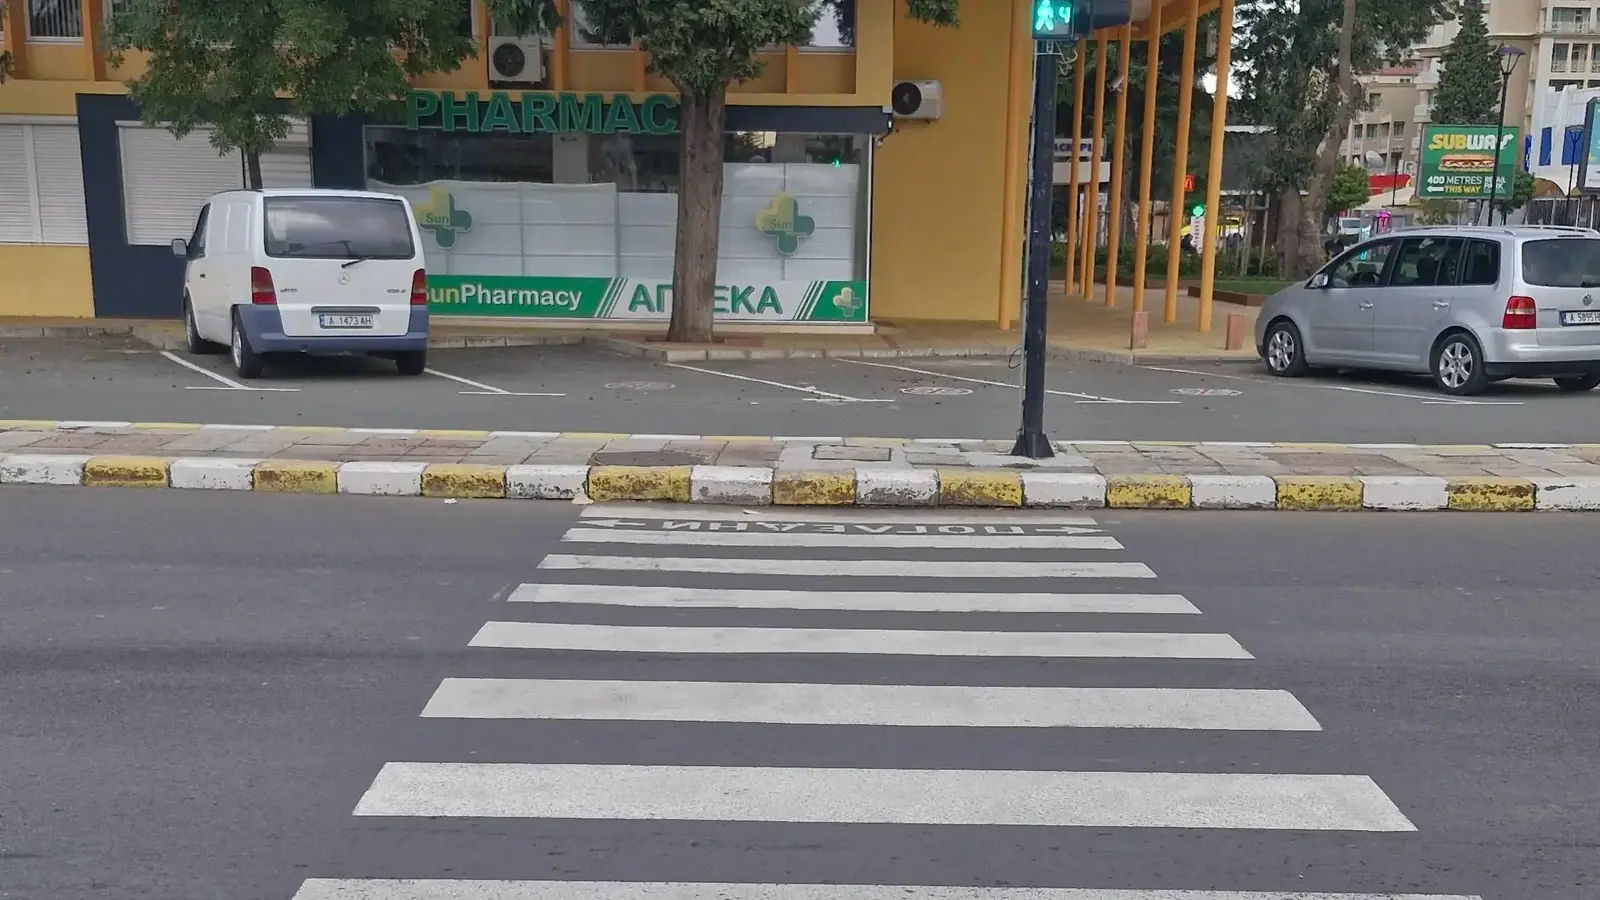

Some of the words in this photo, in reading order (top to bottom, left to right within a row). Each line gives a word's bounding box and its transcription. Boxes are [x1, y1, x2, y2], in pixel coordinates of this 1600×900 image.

[406, 90, 678, 136] PHARMAC
[1428, 133, 1515, 151] SUBWAY
[1427, 175, 1445, 185] 400
[1446, 175, 1483, 185] METRES
[1445, 185, 1463, 193] THIS
[1463, 185, 1482, 194] WAY
[425, 212, 450, 225] Sun
[769, 217, 792, 229] Sun
[628, 283, 784, 315] АПЕКА
